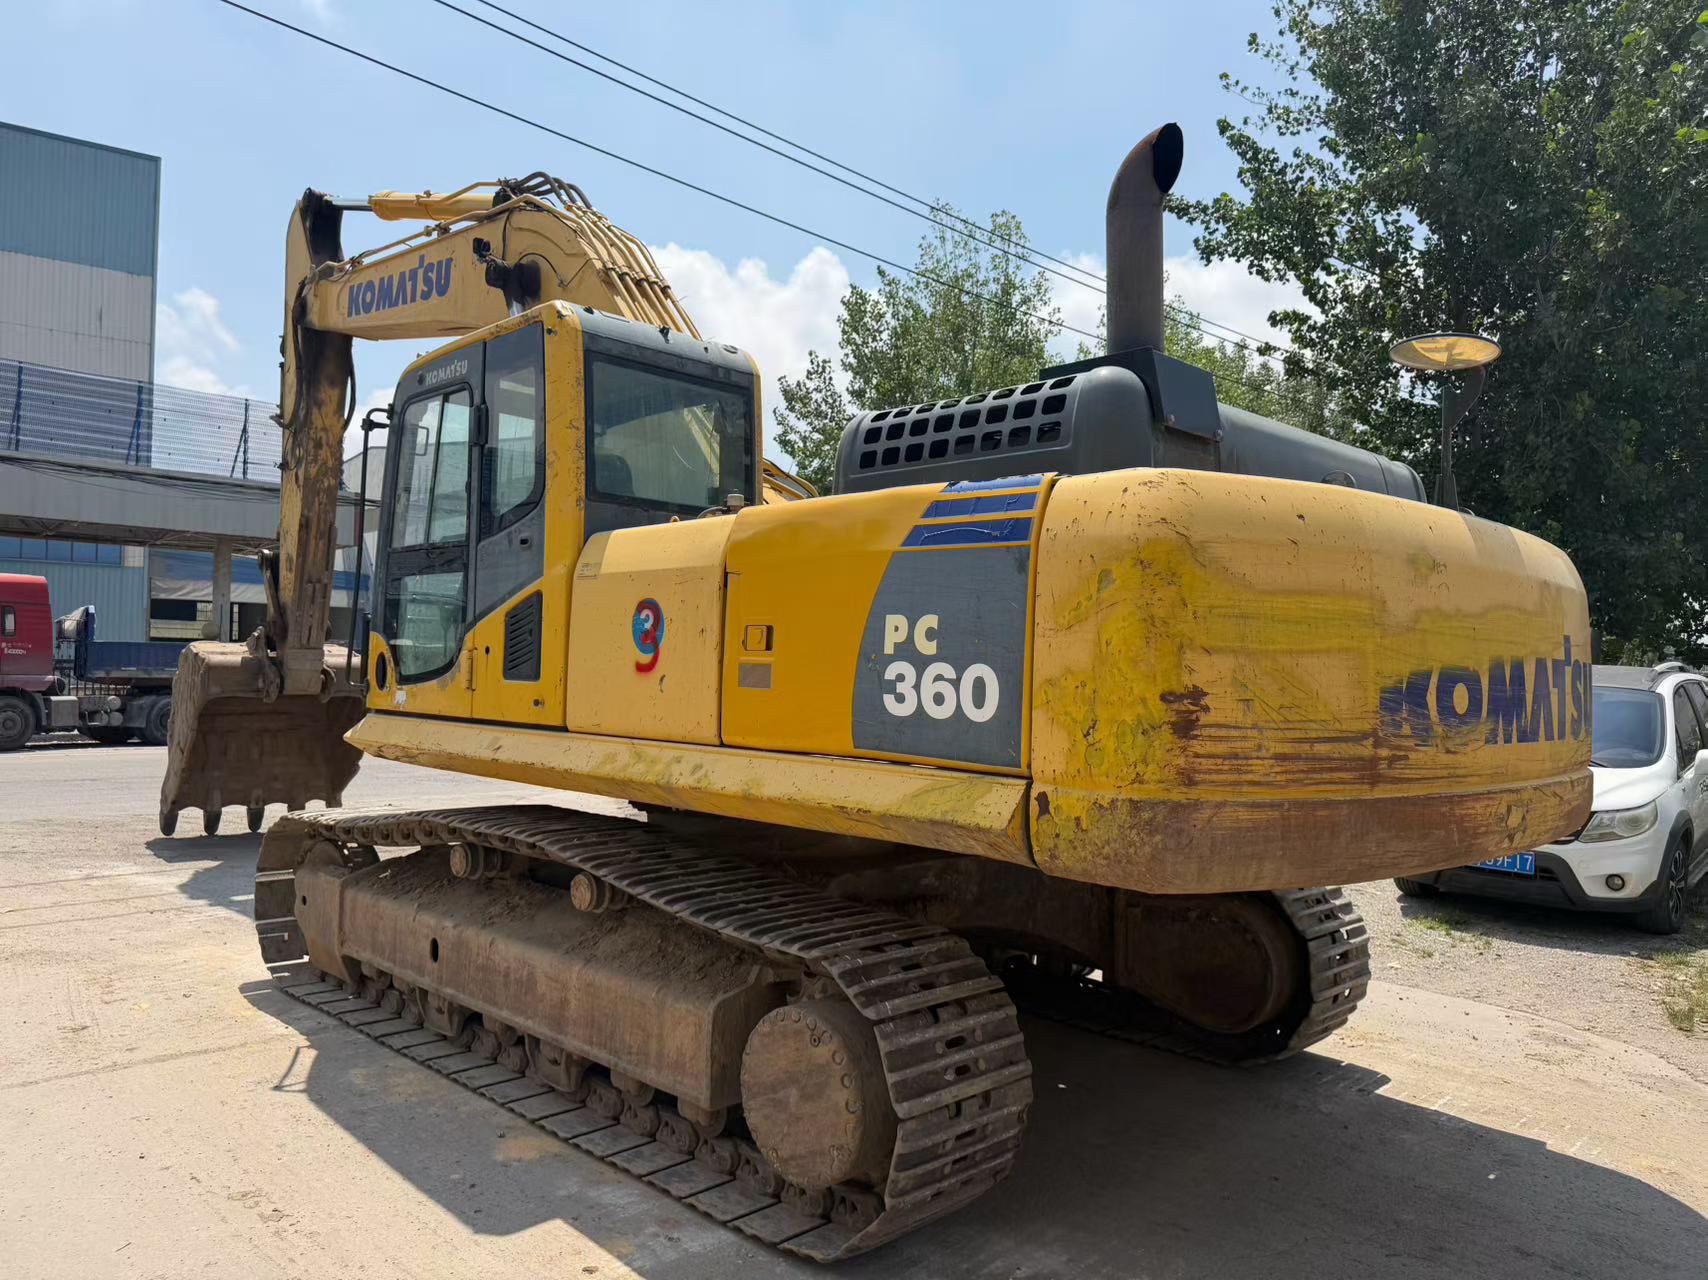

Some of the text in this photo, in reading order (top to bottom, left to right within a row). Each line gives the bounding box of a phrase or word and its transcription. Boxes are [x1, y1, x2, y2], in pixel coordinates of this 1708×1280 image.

[347, 254, 453, 318] KOMATSU
[425, 360, 468, 386] KOMATSU
[883, 614, 939, 655] PC
[882, 660, 1000, 723] 360
